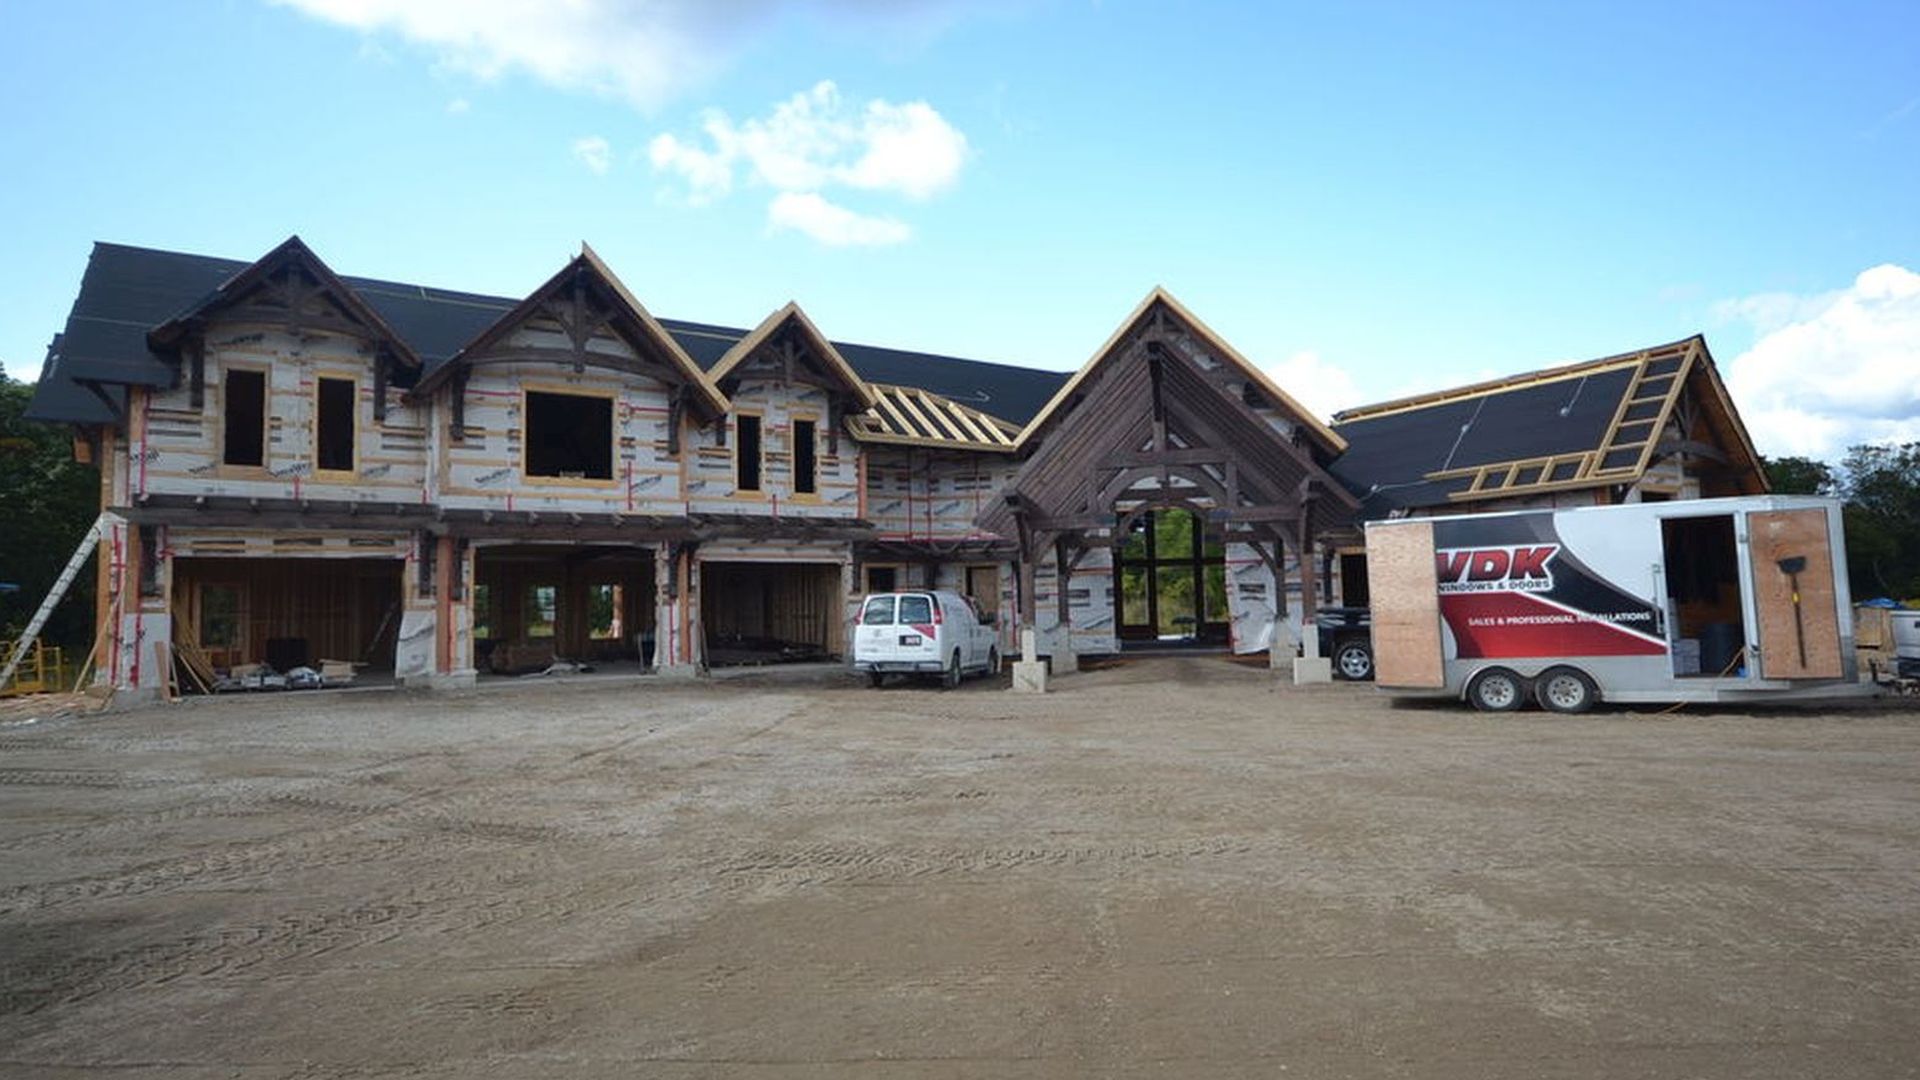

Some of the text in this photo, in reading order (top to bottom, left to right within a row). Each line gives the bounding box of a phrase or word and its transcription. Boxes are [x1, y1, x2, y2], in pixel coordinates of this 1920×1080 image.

[1509, 580, 1549, 590] DOORS
[1468, 617, 1495, 626] SALES
[1497, 616, 1505, 625] &
[1507, 614, 1575, 625] PROFESSIONAL
